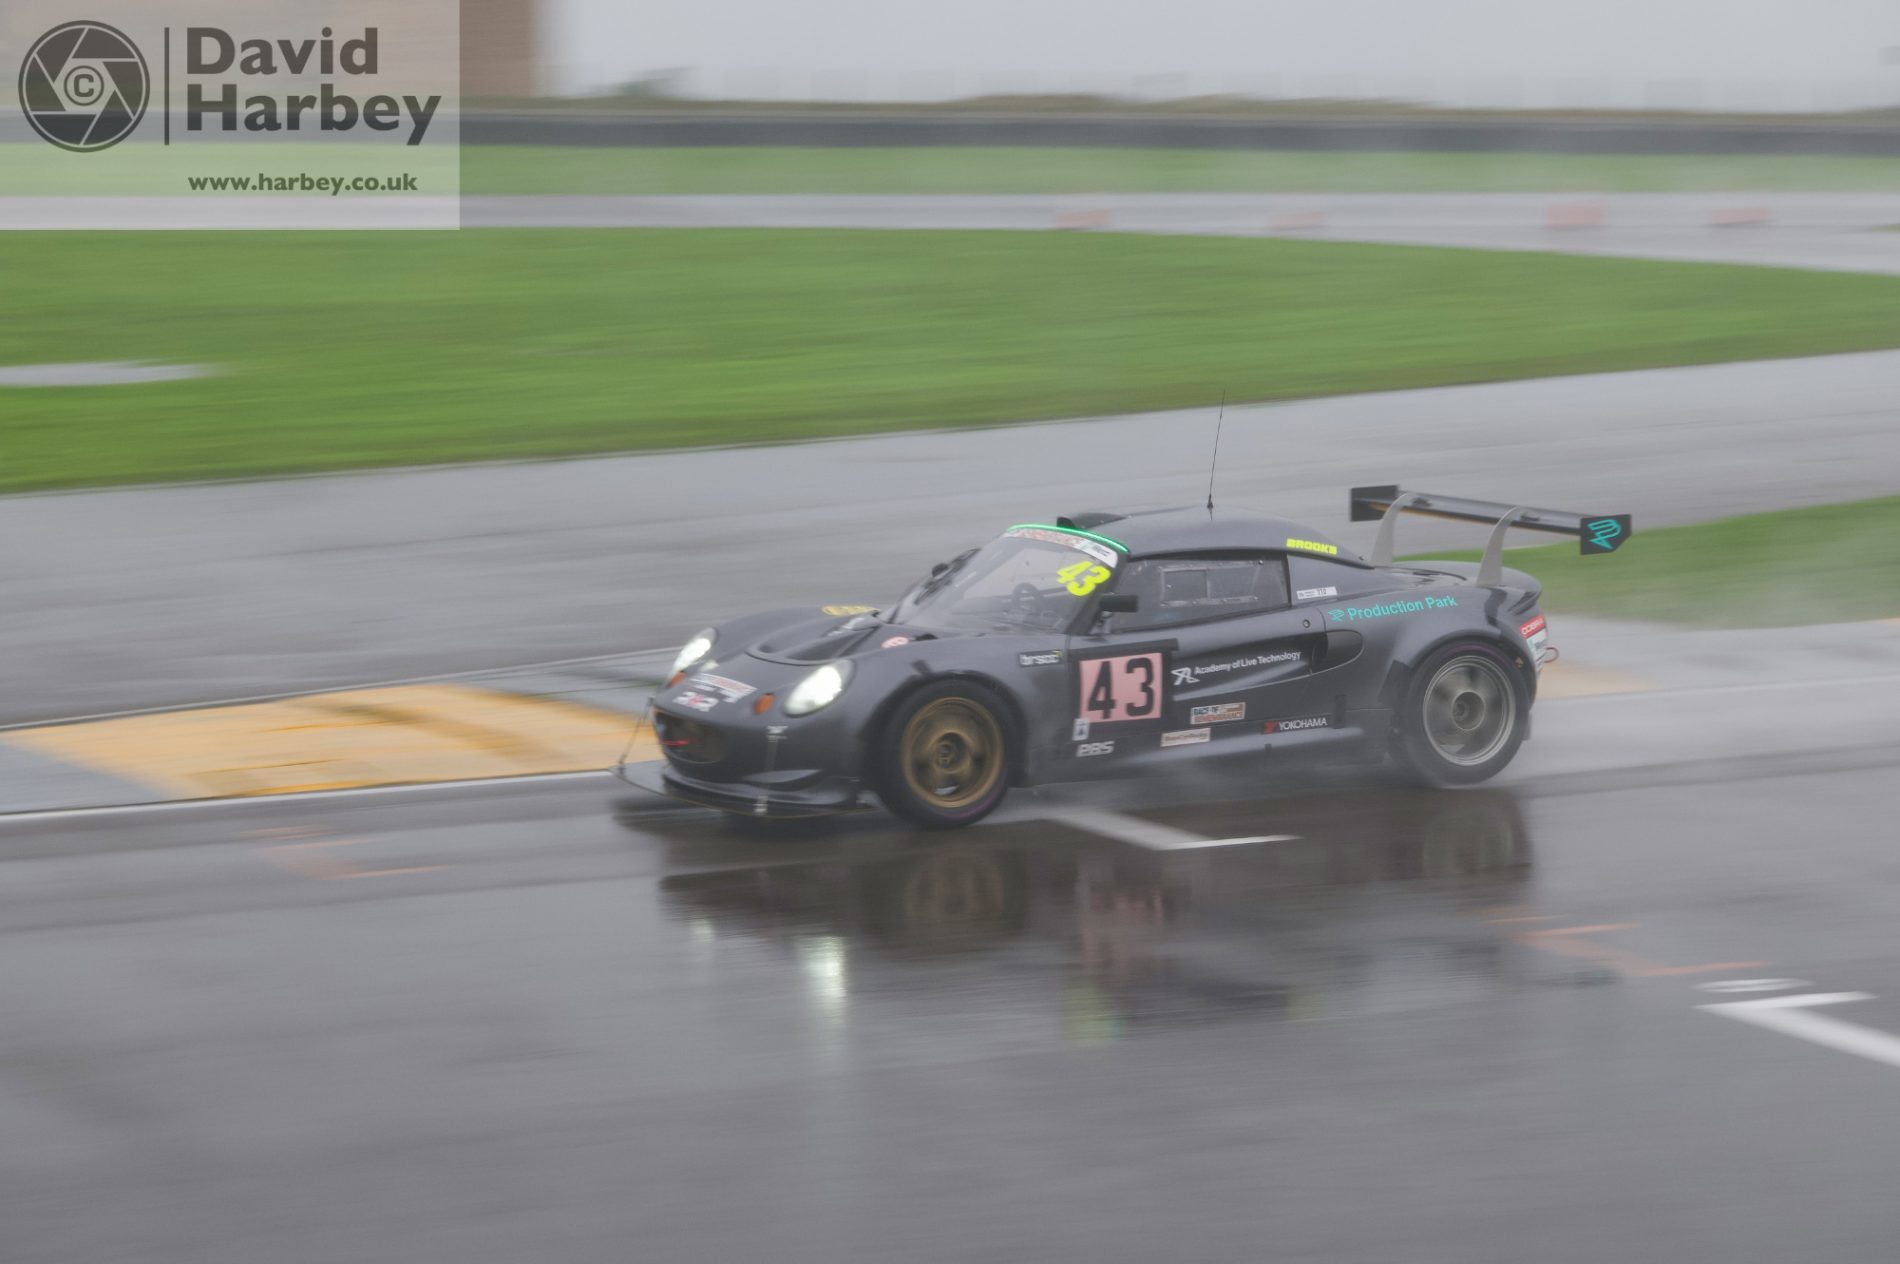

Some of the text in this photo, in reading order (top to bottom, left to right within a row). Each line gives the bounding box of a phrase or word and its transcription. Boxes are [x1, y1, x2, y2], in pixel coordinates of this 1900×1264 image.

[1286, 538, 1337, 555] BROOKS
[1056, 561, 1111, 596] 43
[1347, 595, 1458, 620] Production Park
[1194, 652, 1301, 674] Academy of Live Technology
[1087, 657, 1154, 719] 43
[1279, 717, 1327, 731] YOKOHAMA
